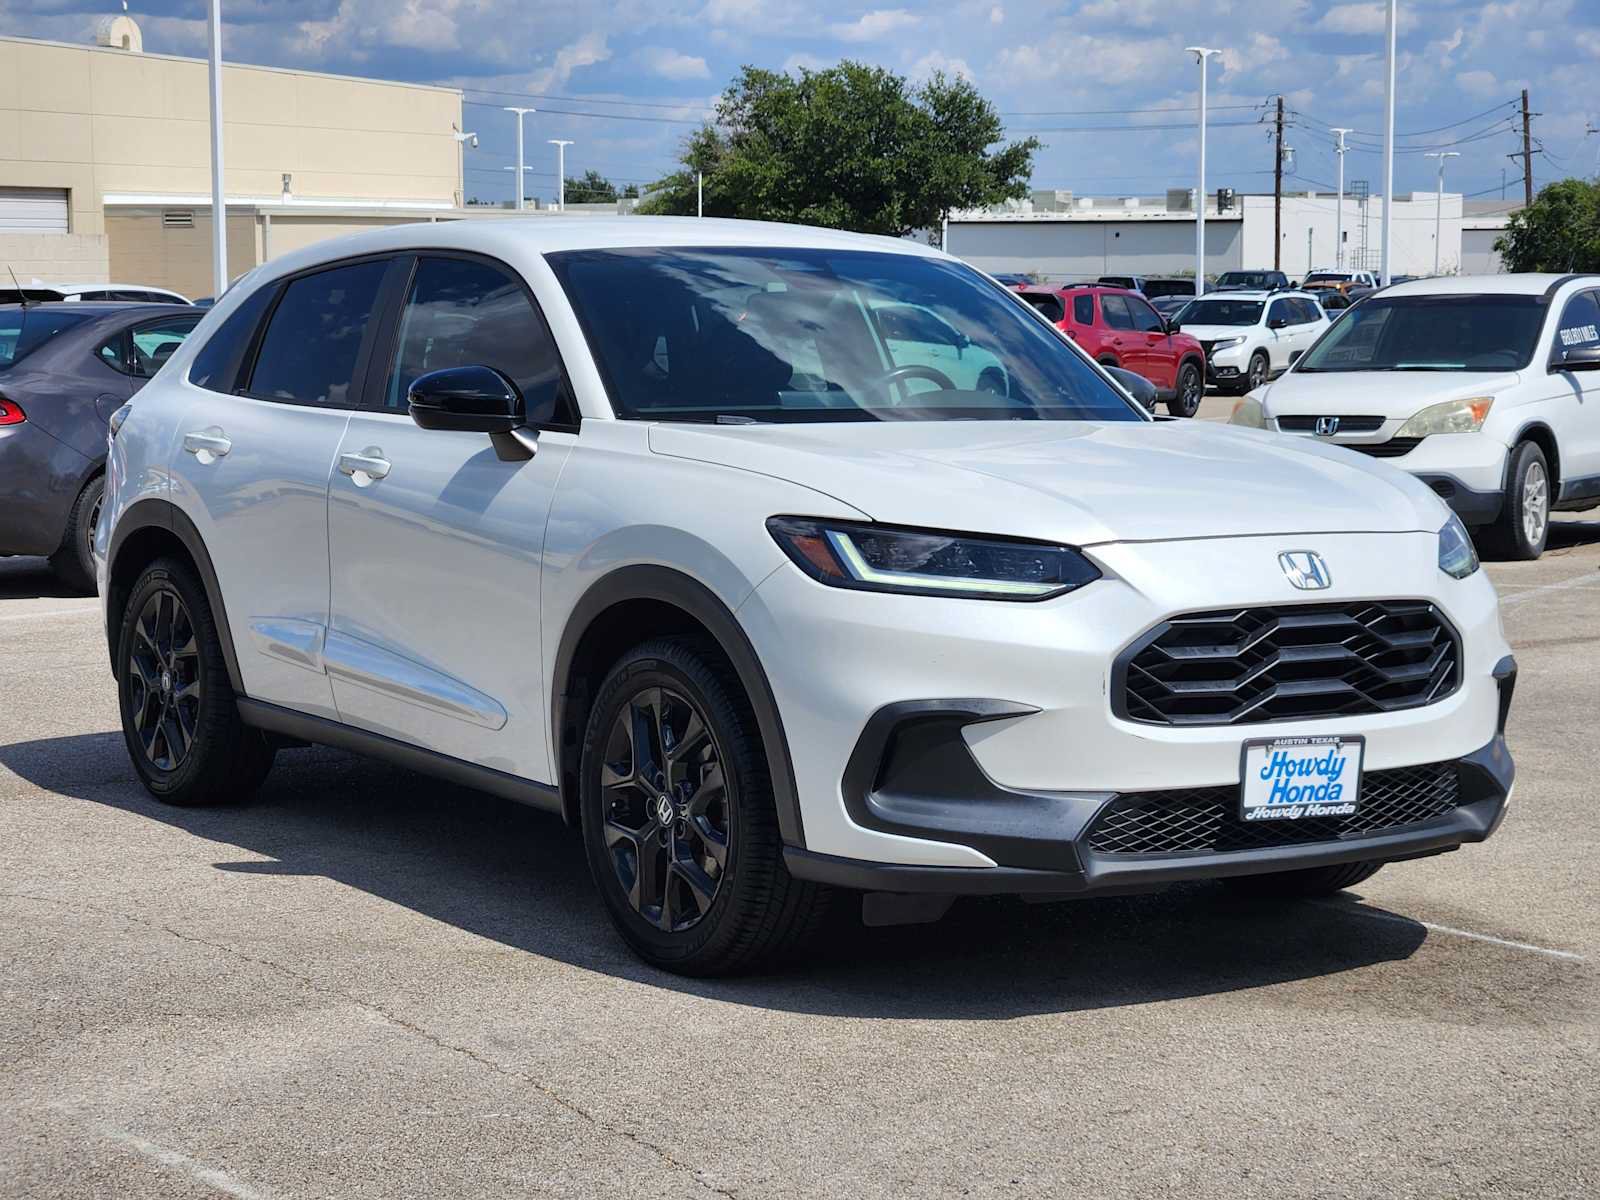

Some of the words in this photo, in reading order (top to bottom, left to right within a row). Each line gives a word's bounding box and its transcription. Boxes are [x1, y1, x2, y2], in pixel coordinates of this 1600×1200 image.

[1260, 750, 1346, 782] Howdy
[1268, 779, 1343, 804] Honda
[1245, 805, 1305, 819] Howdy
[1304, 803, 1356, 816] Honda
